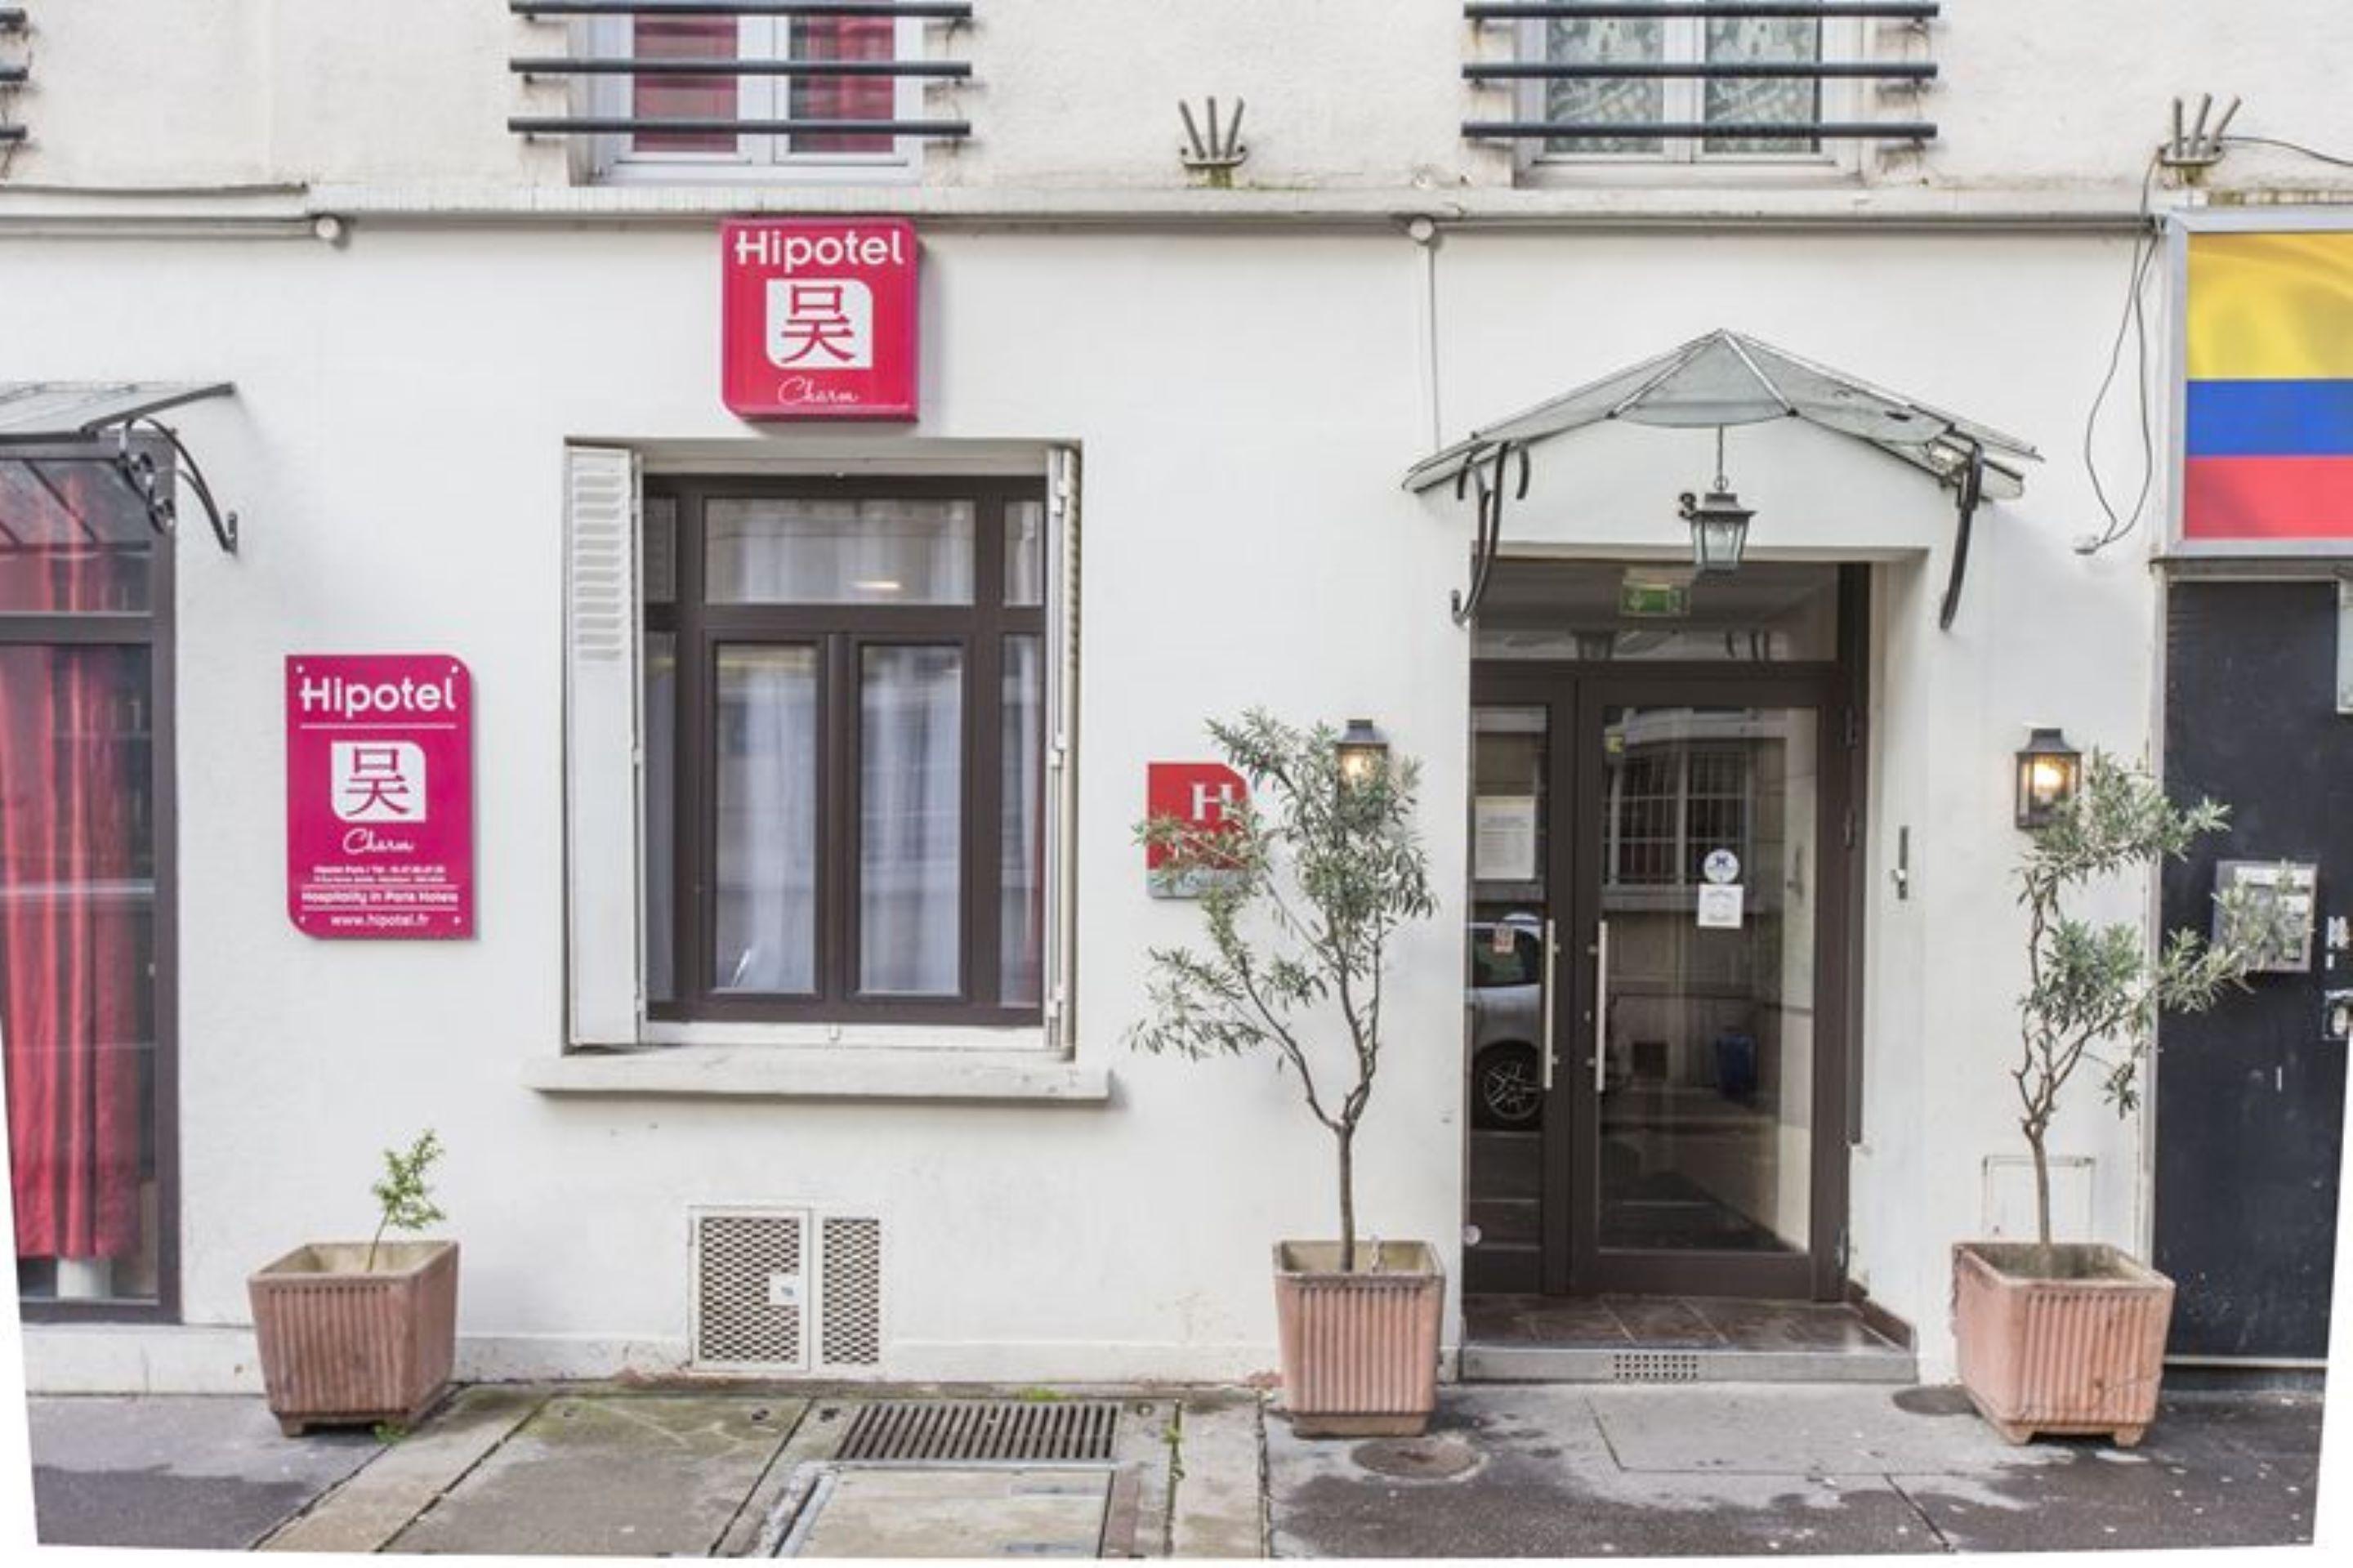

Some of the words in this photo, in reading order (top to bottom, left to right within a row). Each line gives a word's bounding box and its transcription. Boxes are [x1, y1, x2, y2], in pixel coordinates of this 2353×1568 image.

[734, 230, 904, 274] Hipotel
[778, 375, 860, 406] Charm
[299, 677, 457, 719] Hipotel
[1191, 783, 1234, 821] H
[342, 827, 415, 855] Charm
